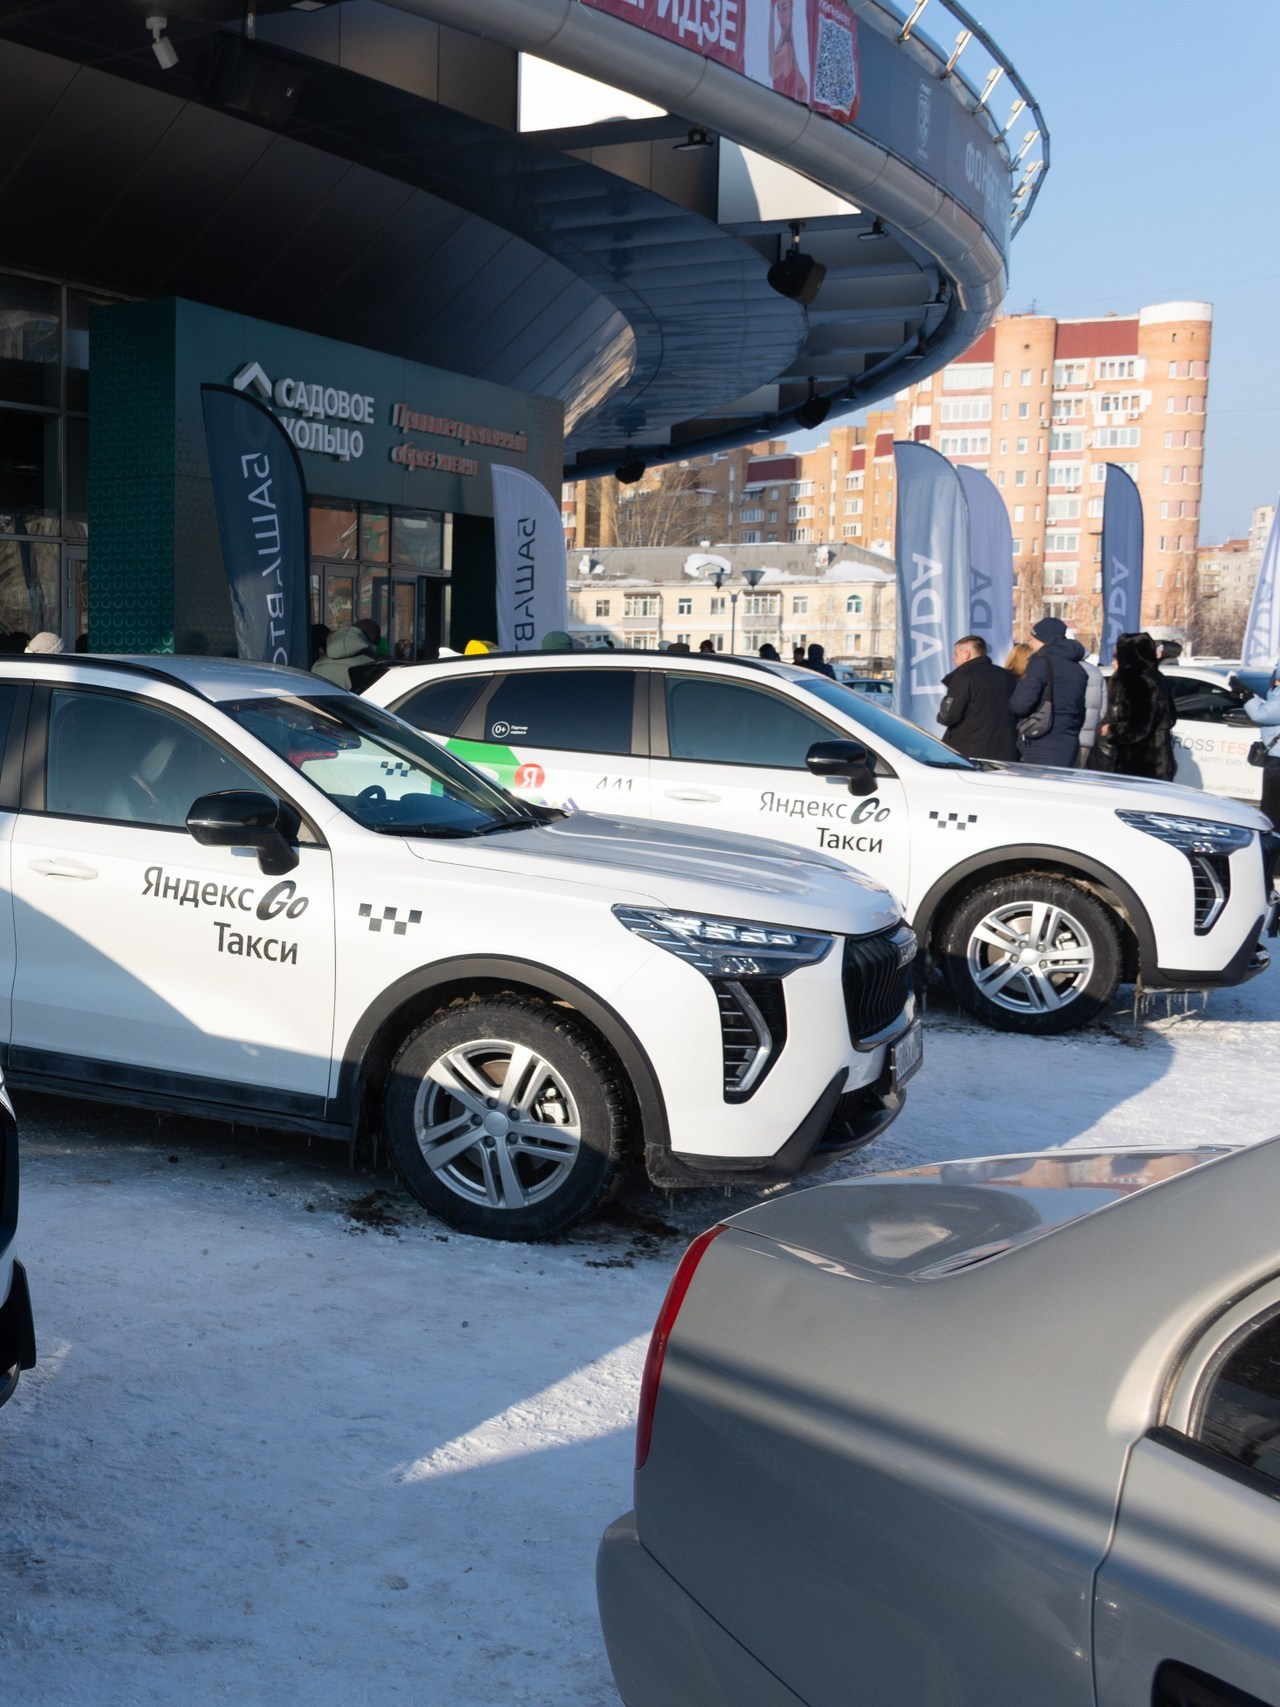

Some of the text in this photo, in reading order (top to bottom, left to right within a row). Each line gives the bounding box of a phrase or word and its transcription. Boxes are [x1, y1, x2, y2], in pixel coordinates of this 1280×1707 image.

[275, 378, 375, 424] САДОВОЕ
[1172, 736, 1251, 756] ROSS TES
[520, 767, 537, 788] Я
[759, 791, 891, 825] Яндекс Go
[816, 827, 883, 854] Такси
[141, 865, 309, 921] Яндекс Go
[213, 921, 298, 965] Такси
